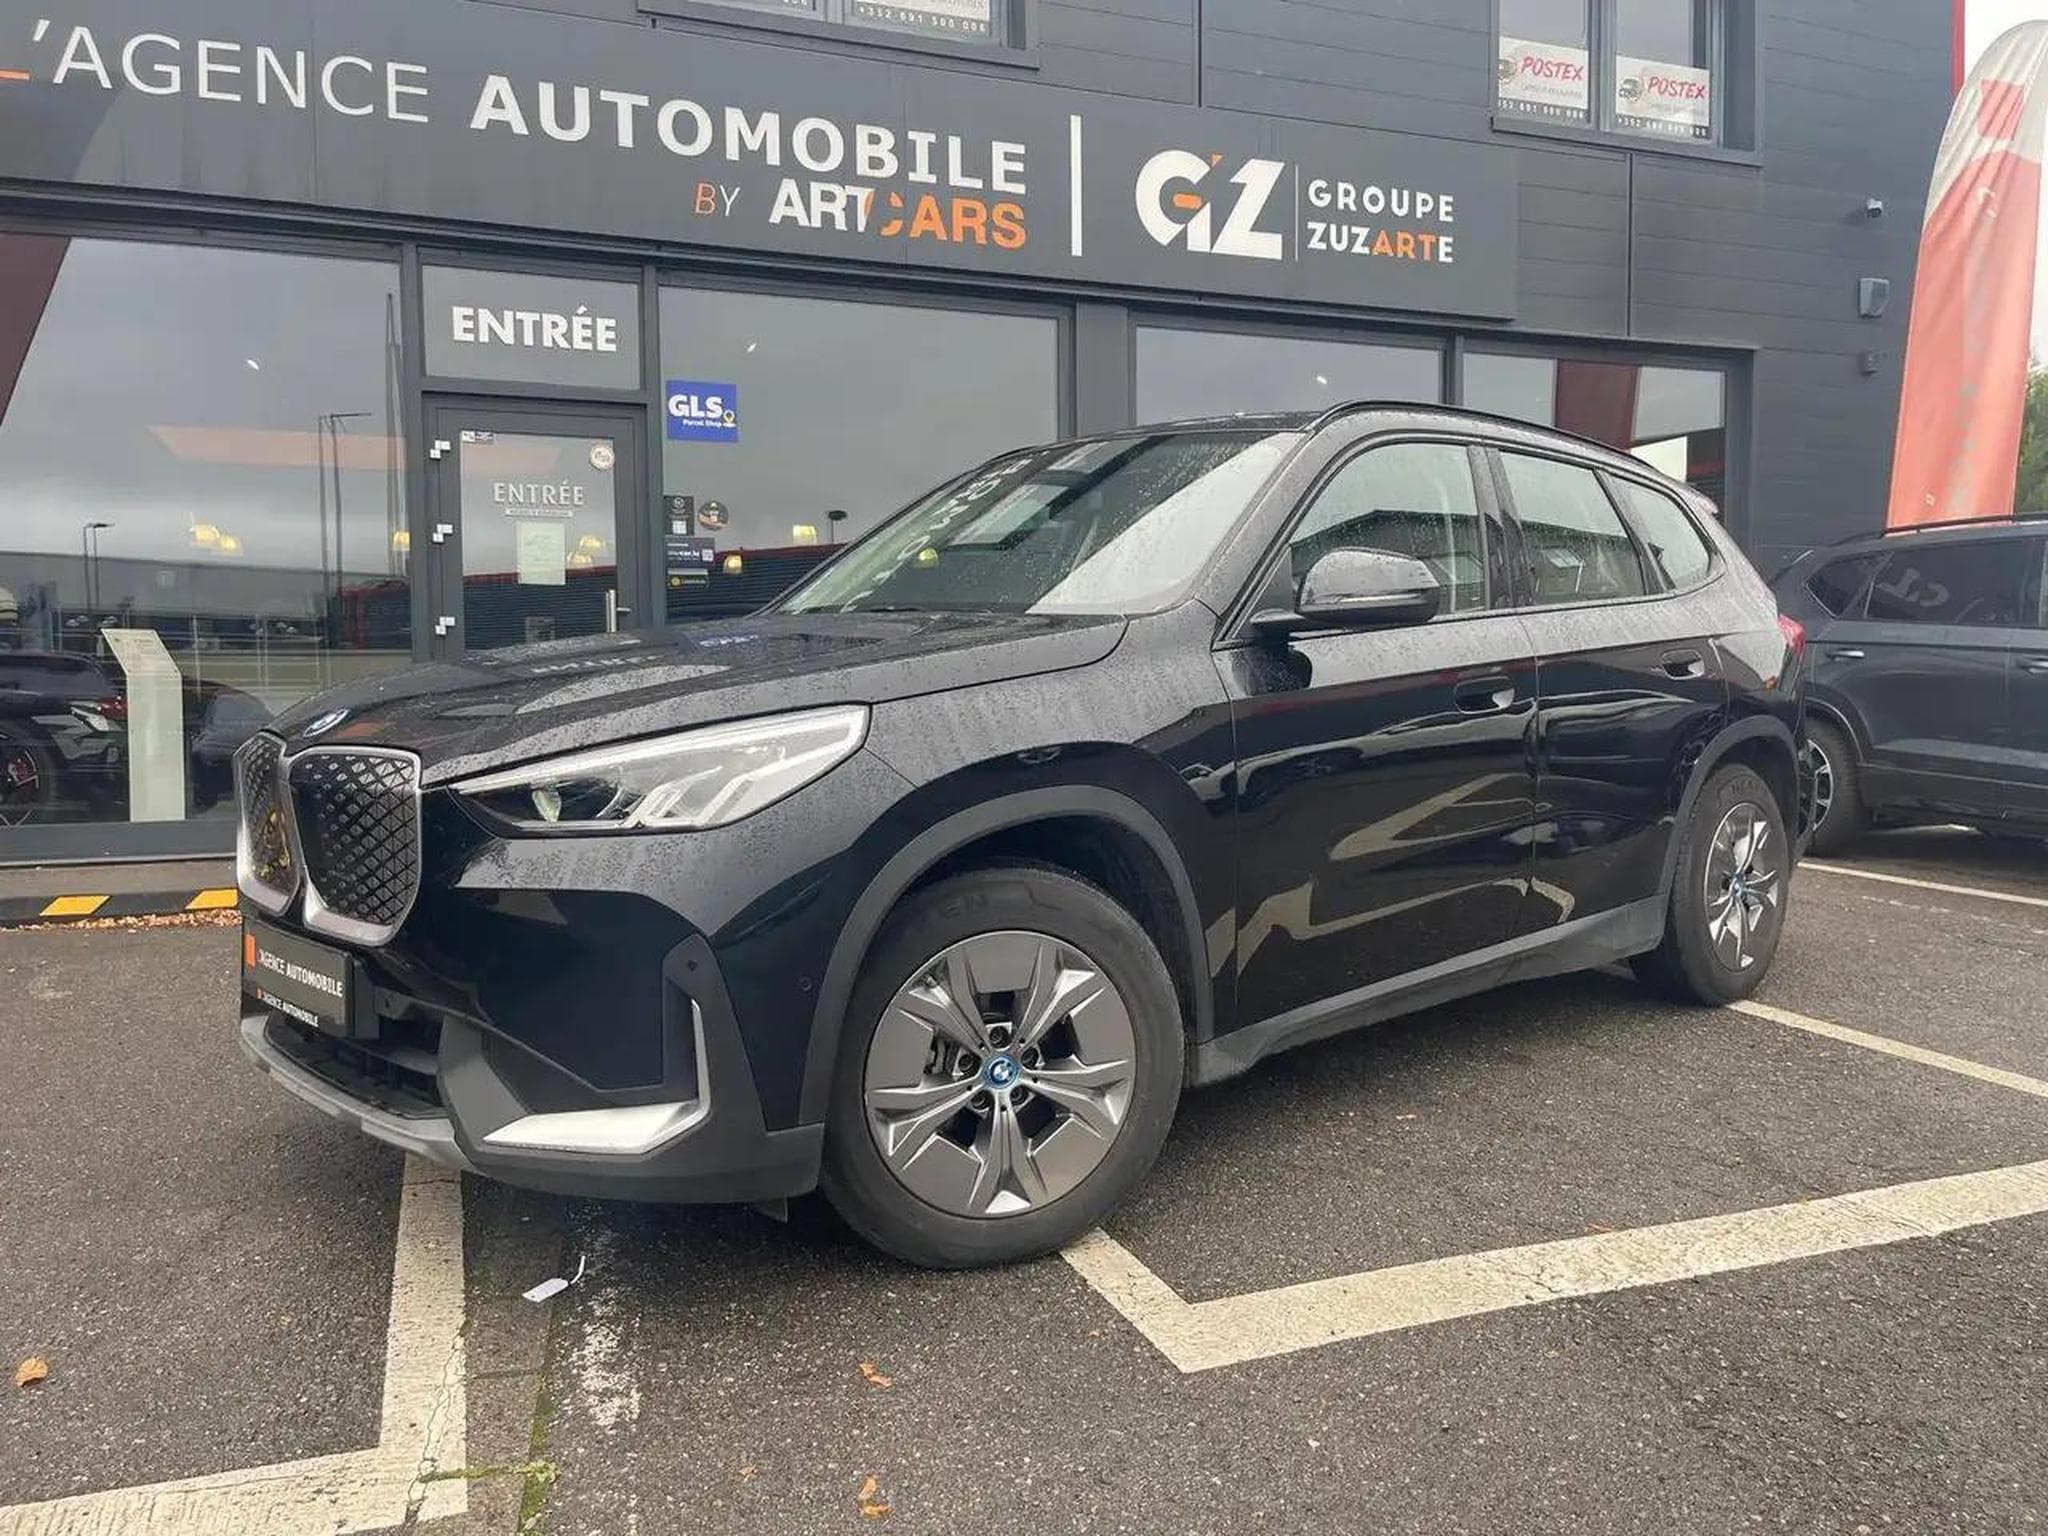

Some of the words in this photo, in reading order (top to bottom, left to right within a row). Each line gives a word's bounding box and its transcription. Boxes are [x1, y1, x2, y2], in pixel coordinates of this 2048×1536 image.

[1521, 55, 1584, 82] POSTEX
[1647, 75, 1706, 100] POSTEX
[0, 19, 429, 122] 'AGENCE
[470, 74, 1027, 195] AUTOMOBILE
[694, 179, 741, 218] BY
[1307, 178, 1454, 222] GROUPE
[1306, 221, 1454, 264] ZUZARTE
[451, 305, 618, 353] ENTRÉE
[668, 393, 724, 419] GLS
[493, 479, 585, 506] ENTRÉE
[286, 963, 344, 998] AUTOMOBILE
